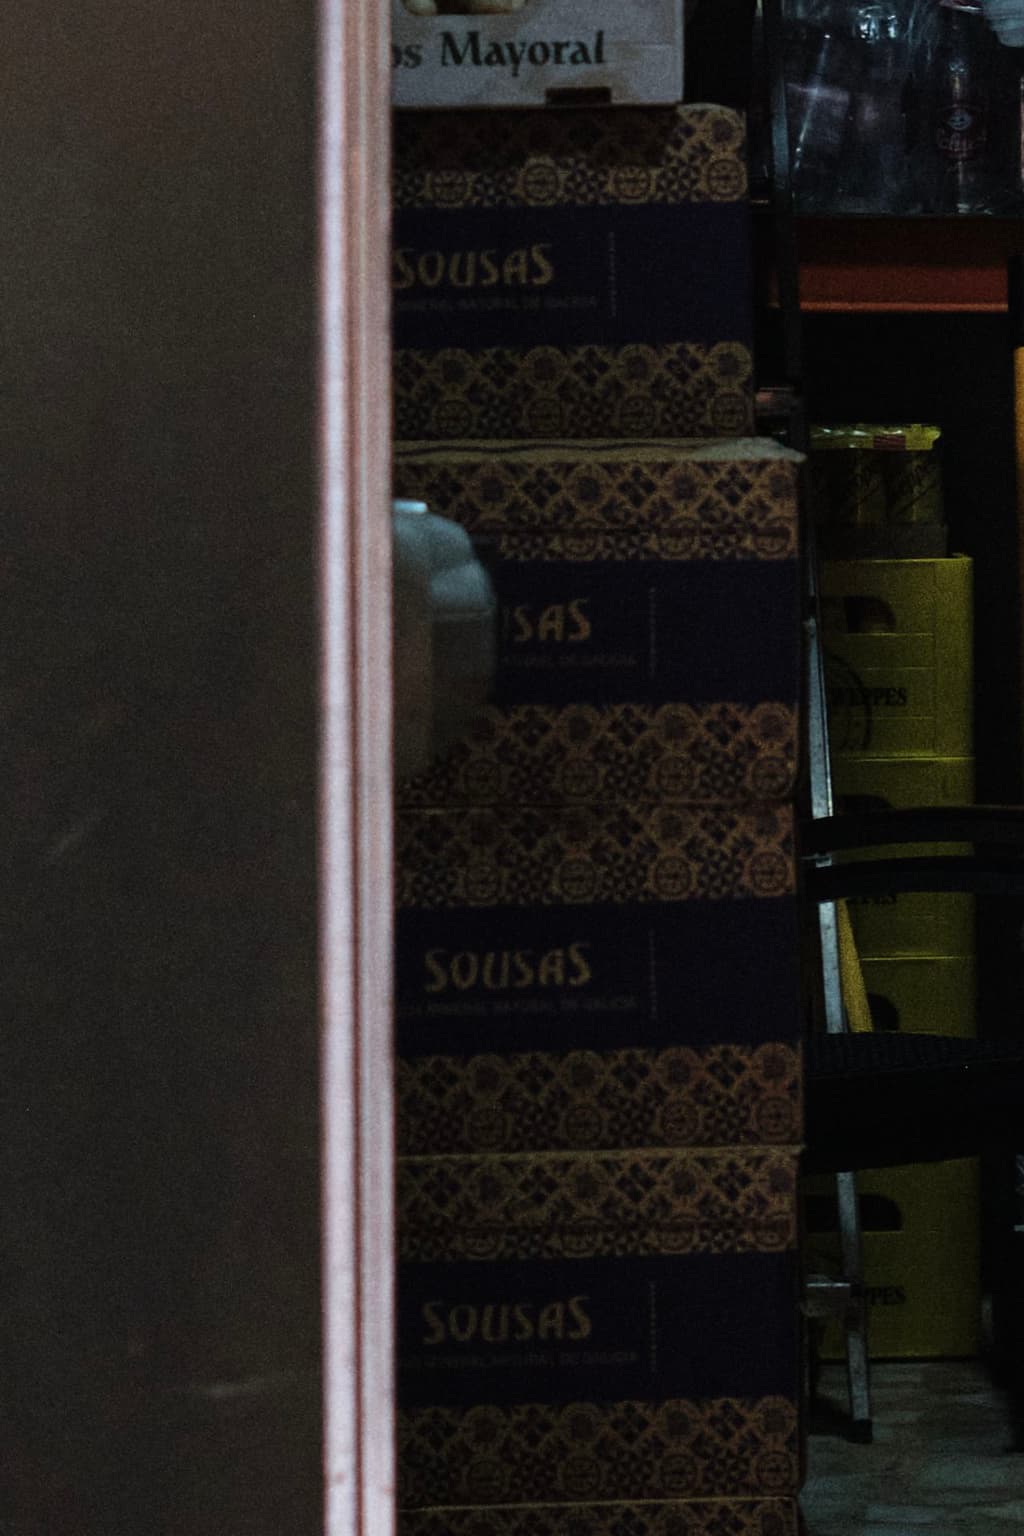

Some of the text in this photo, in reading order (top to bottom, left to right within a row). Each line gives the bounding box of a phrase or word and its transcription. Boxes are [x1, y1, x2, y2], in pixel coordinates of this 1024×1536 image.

[440, 30, 607, 77] Mayoral
[393, 243, 555, 289] SOUSAS
[505, 597, 592, 643] SAS
[422, 942, 593, 994] SOUSAS
[420, 1293, 593, 1346] SOUSAS
